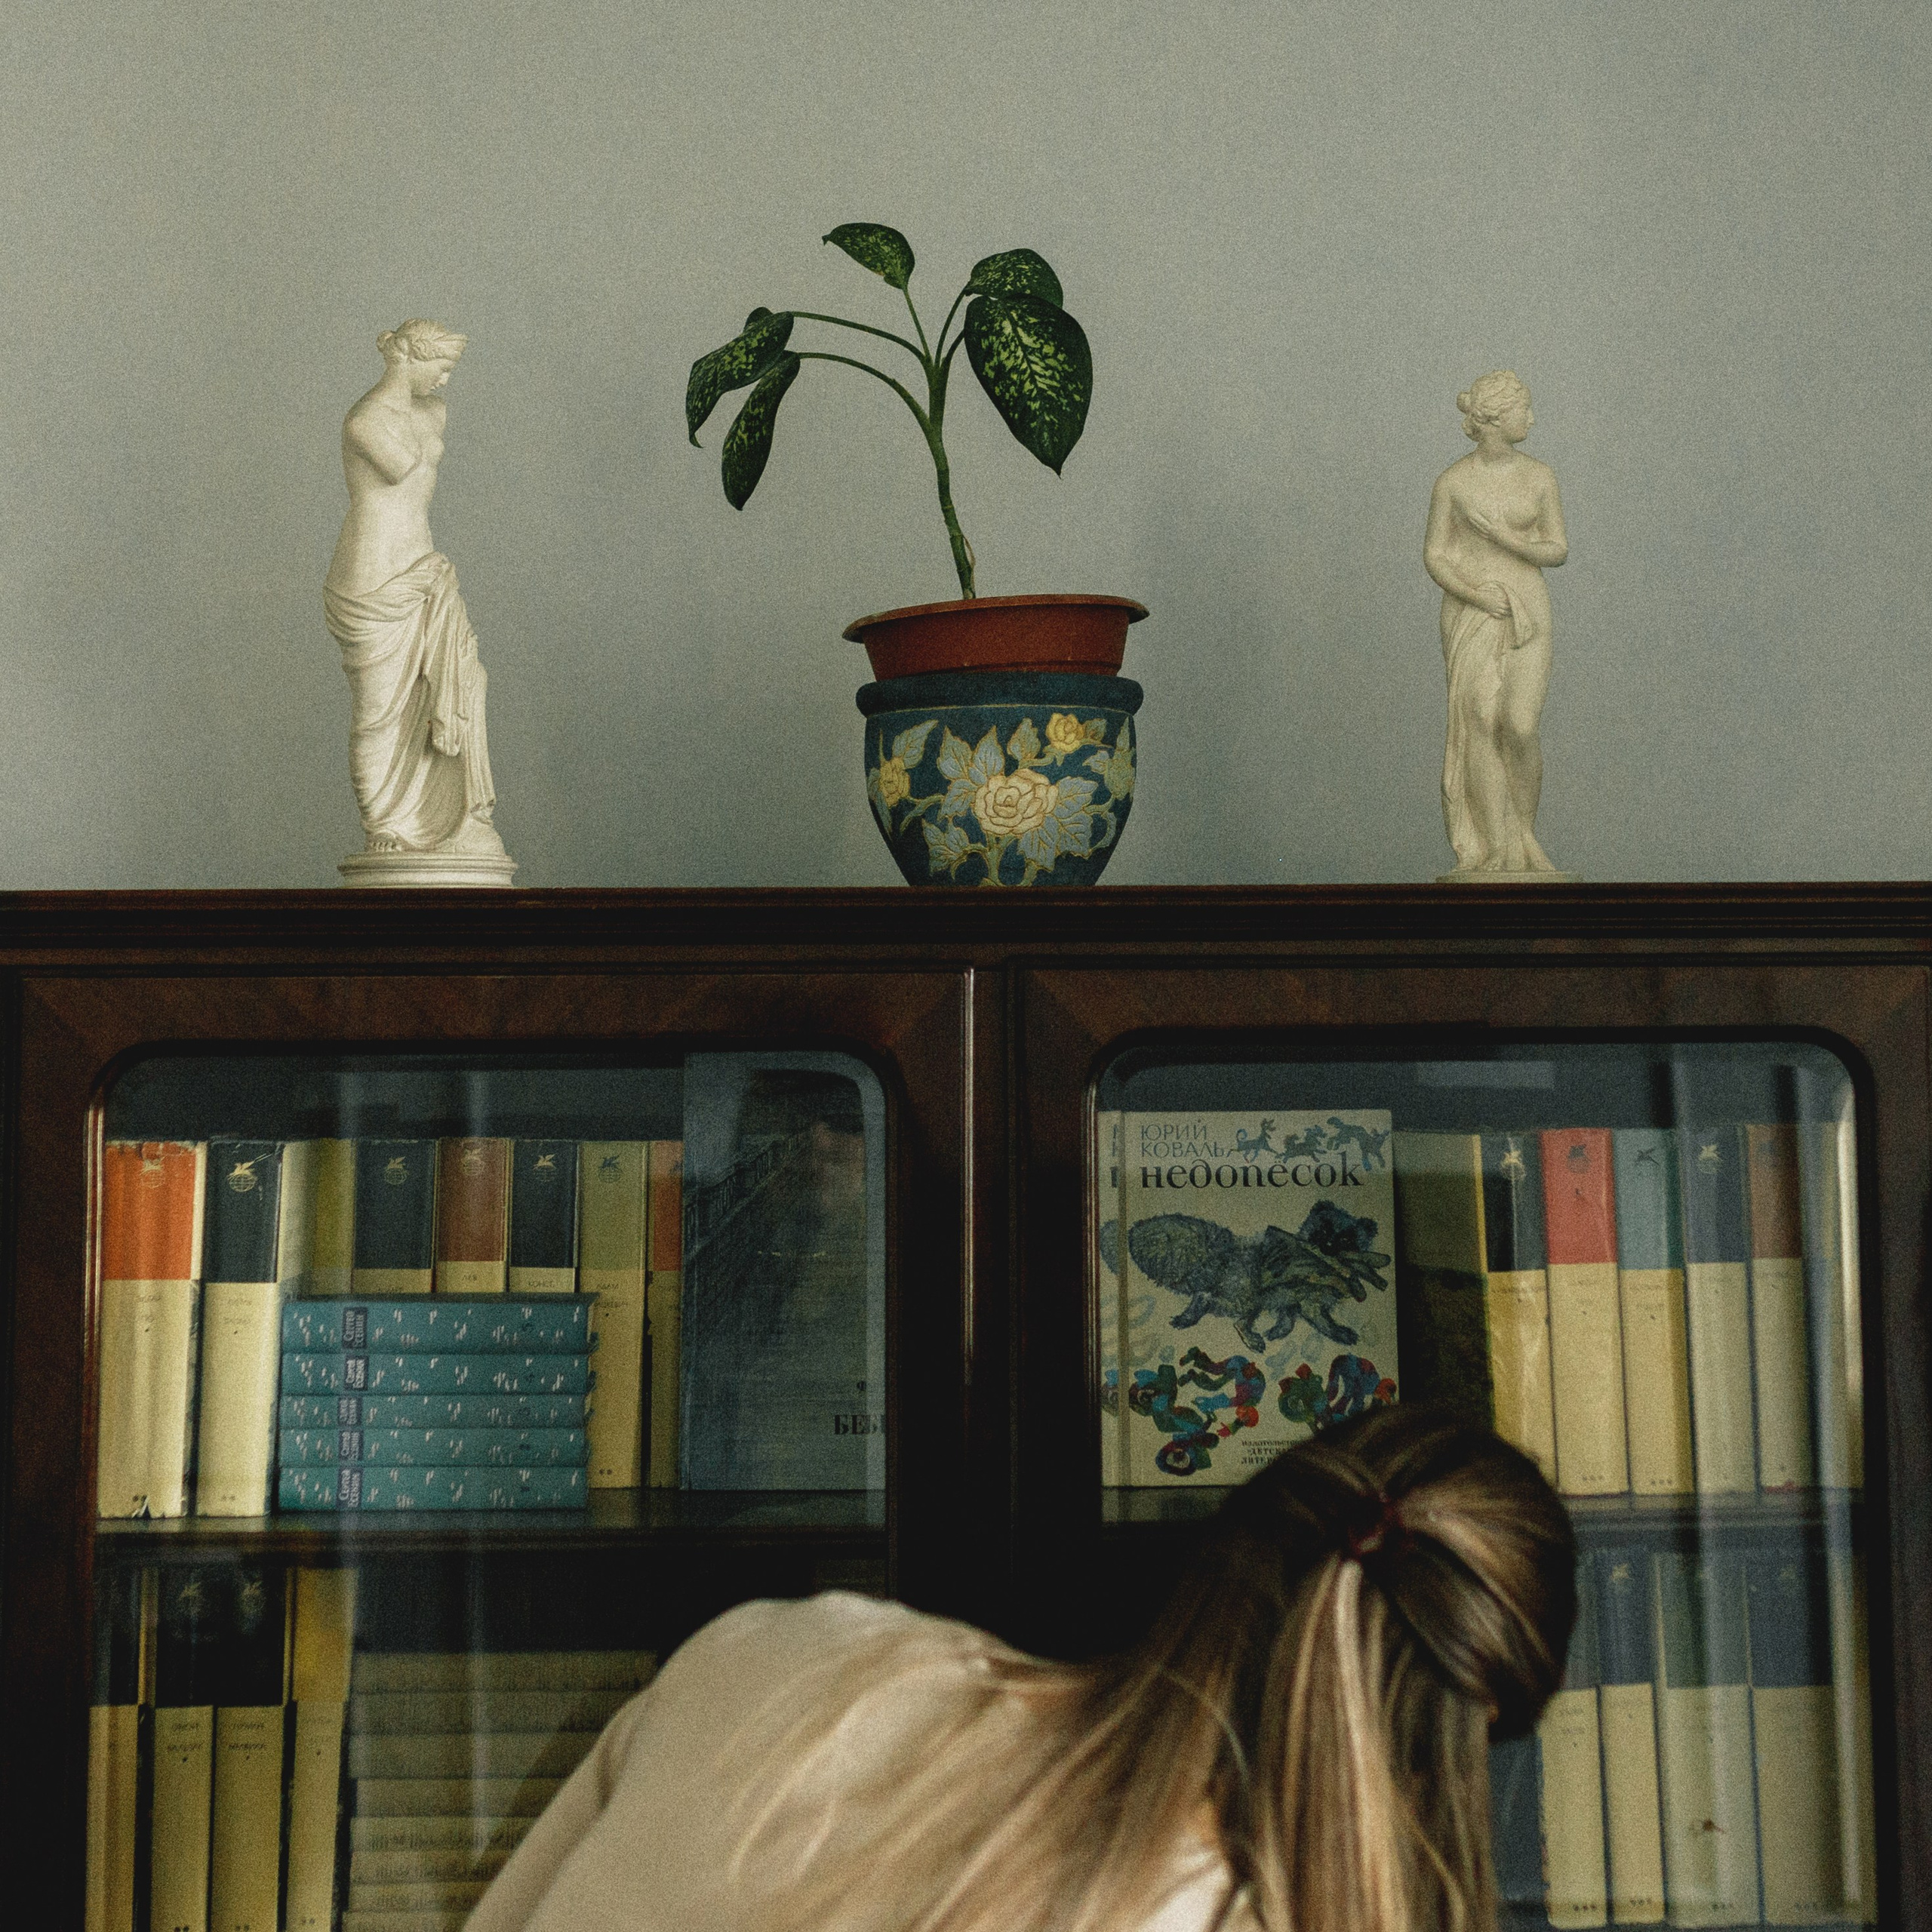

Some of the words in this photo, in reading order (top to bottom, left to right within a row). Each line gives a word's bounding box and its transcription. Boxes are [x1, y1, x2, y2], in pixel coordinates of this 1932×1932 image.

[1140, 1118, 1208, 1141] ЮРИЙ
[1140, 1140, 1224, 1158] КОВАЛЬ
[1140, 1152, 1366, 1189] недопёсок
